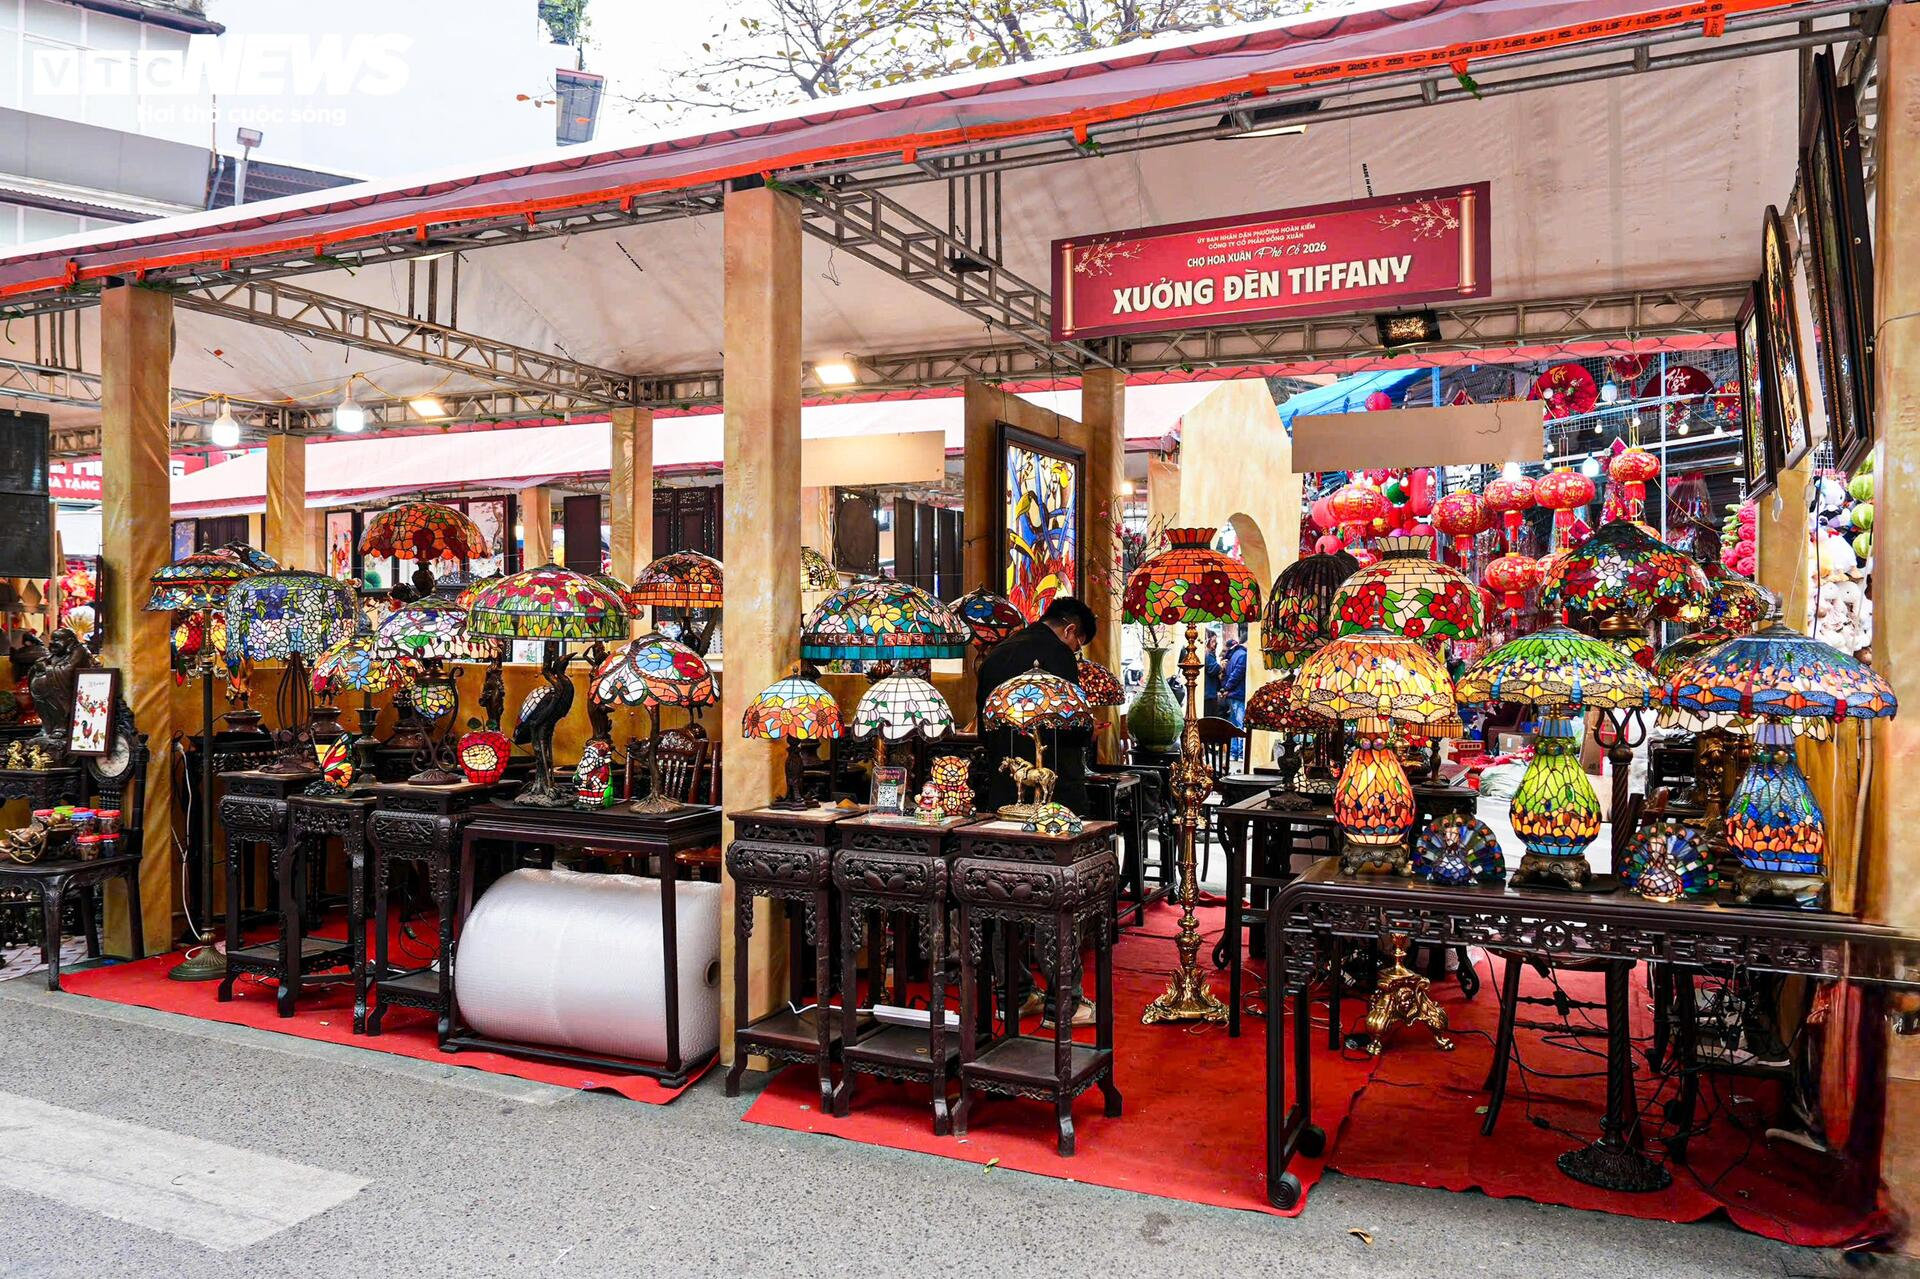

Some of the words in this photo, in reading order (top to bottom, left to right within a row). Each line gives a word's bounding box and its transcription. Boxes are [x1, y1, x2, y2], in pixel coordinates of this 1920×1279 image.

[1208, 241, 1227, 250] CÔNG
[1286, 231, 1304, 240] XUÂN
[1187, 257, 1206, 268] CHỢ
[1207, 255, 1227, 265] HOA
[1228, 250, 1252, 263] XUÂN
[1303, 241, 1327, 254] 2026
[1112, 276, 1214, 314] XƯỞNG
[1223, 267, 1280, 302] ĐÈN
[1287, 254, 1413, 295] TIFFANY
